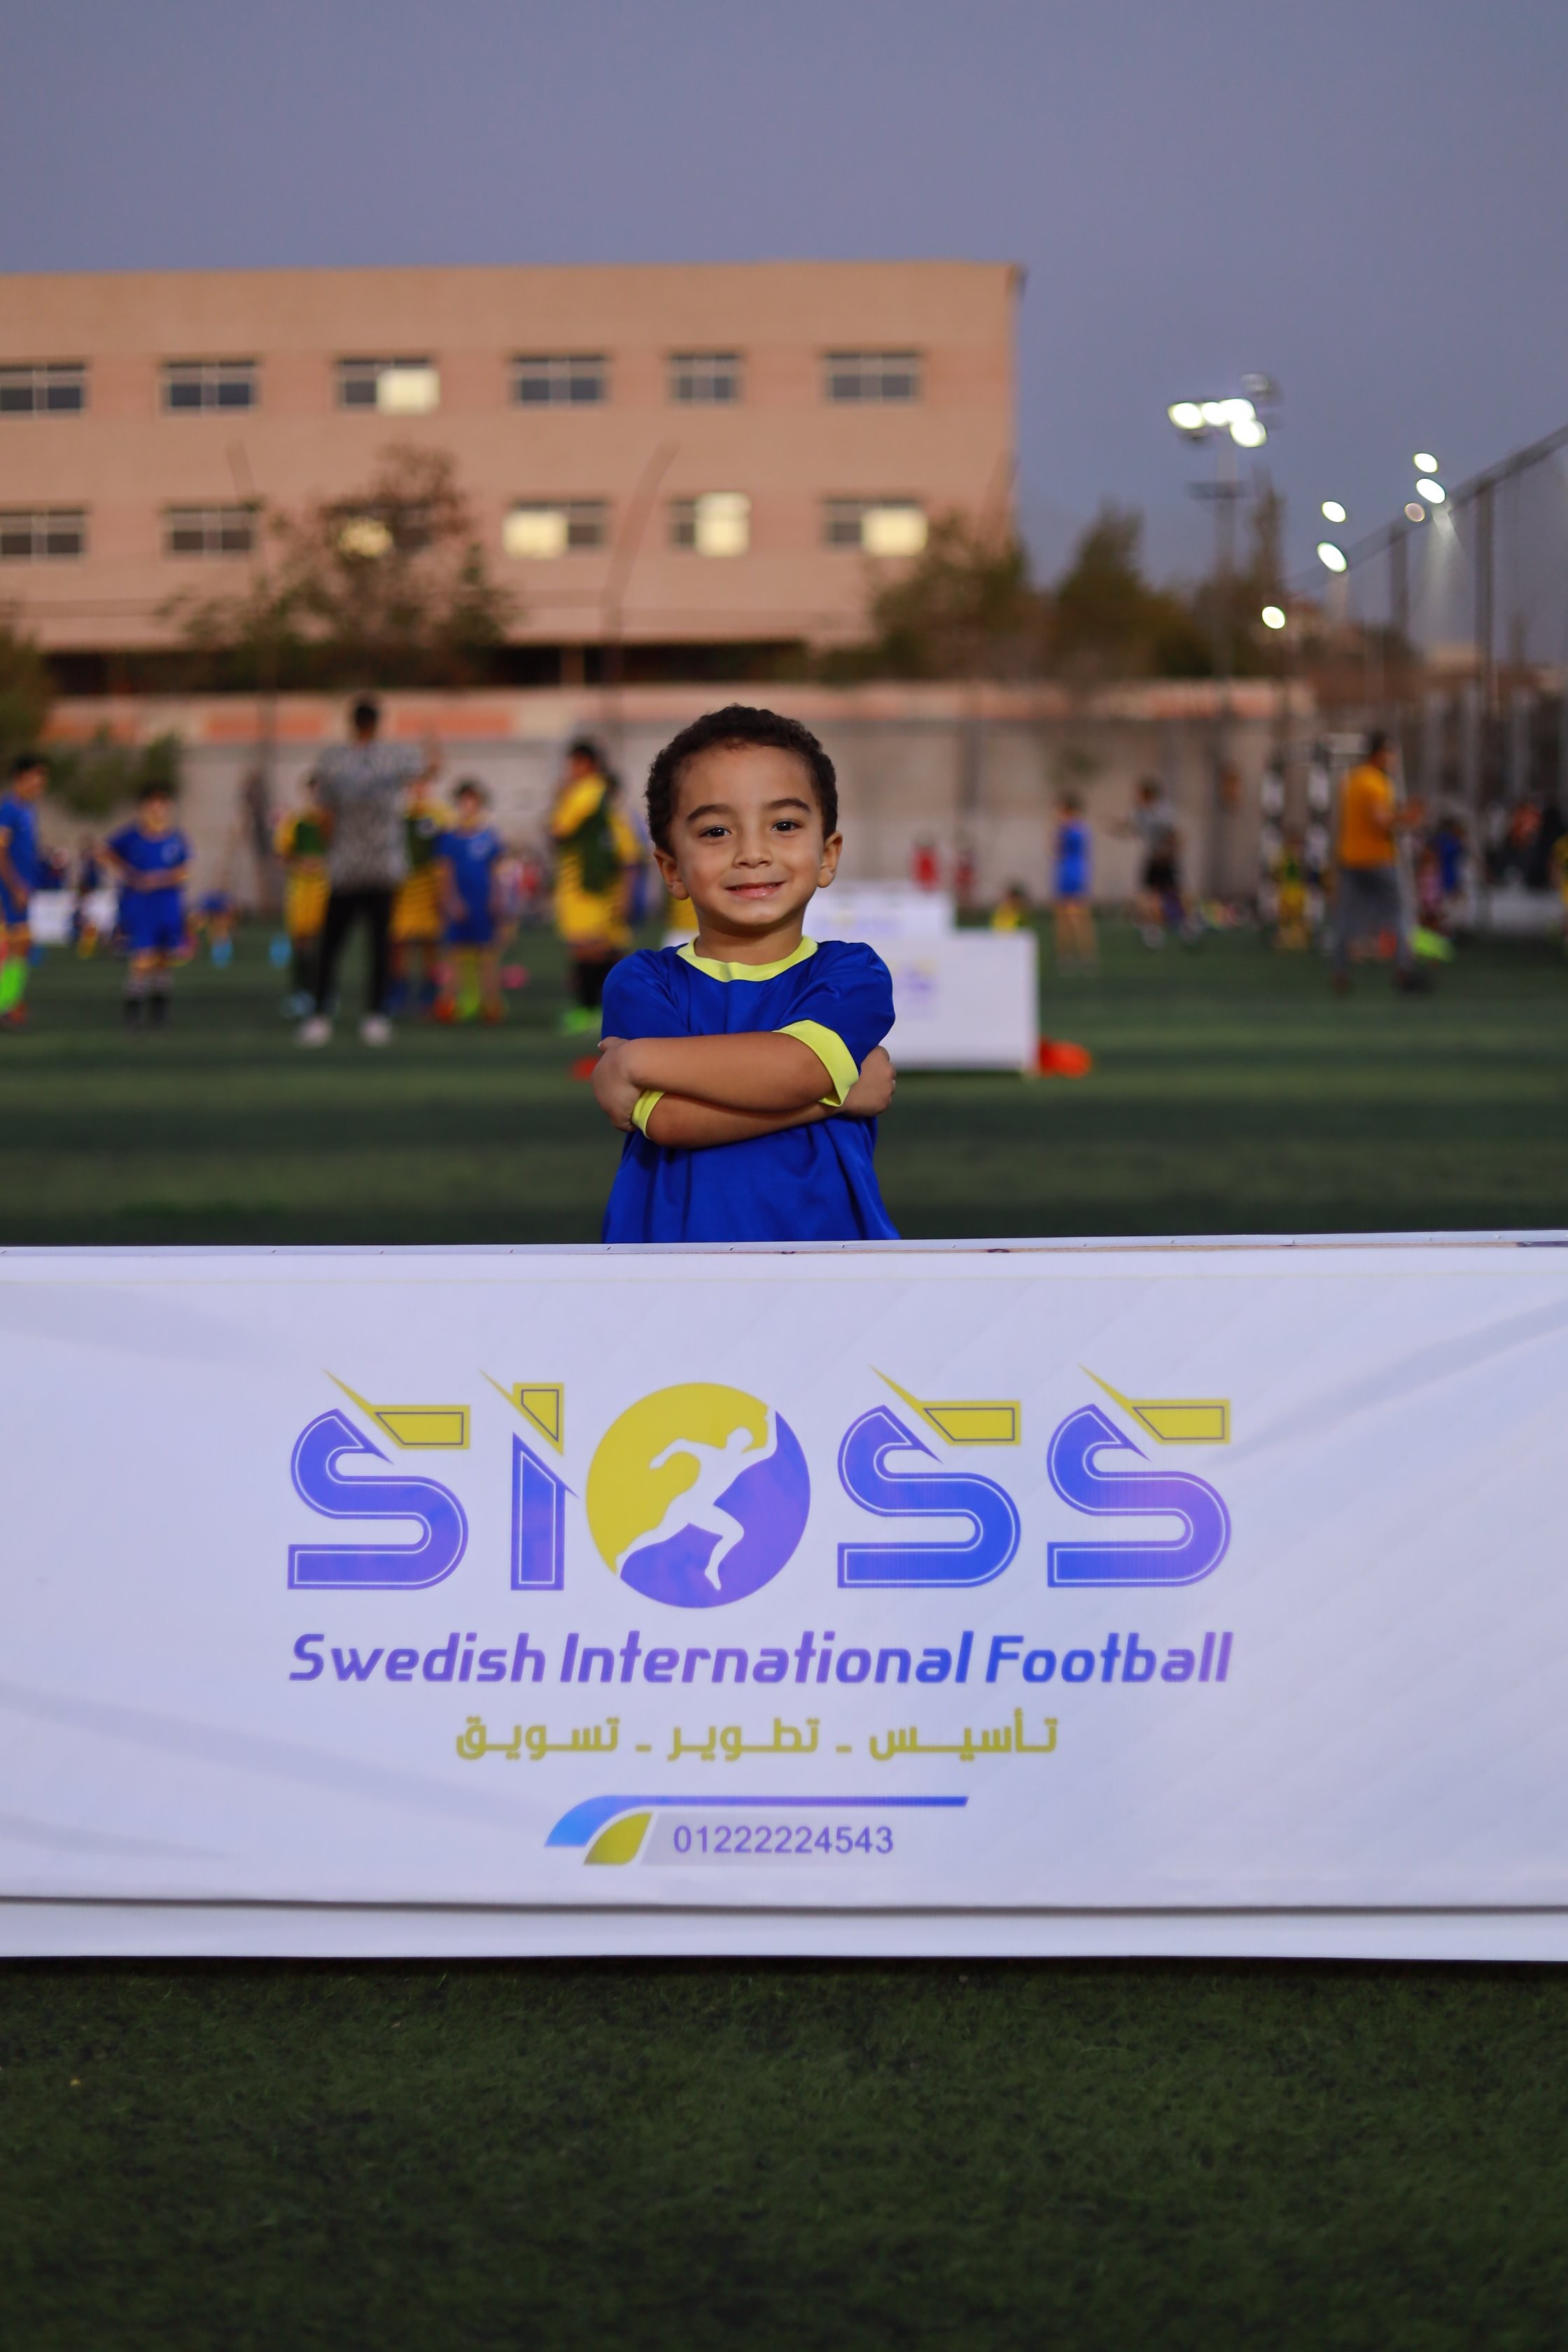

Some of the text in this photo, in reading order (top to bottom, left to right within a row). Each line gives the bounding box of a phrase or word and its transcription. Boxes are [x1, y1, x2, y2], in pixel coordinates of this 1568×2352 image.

[288, 1630, 1234, 1684] Swedish International Football
[455, 1715, 621, 1762] تسويق
[666, 1716, 820, 1763] تطوير
[868, 1707, 1058, 1763] تأسيس
[673, 1824, 895, 1855] 01222224543
